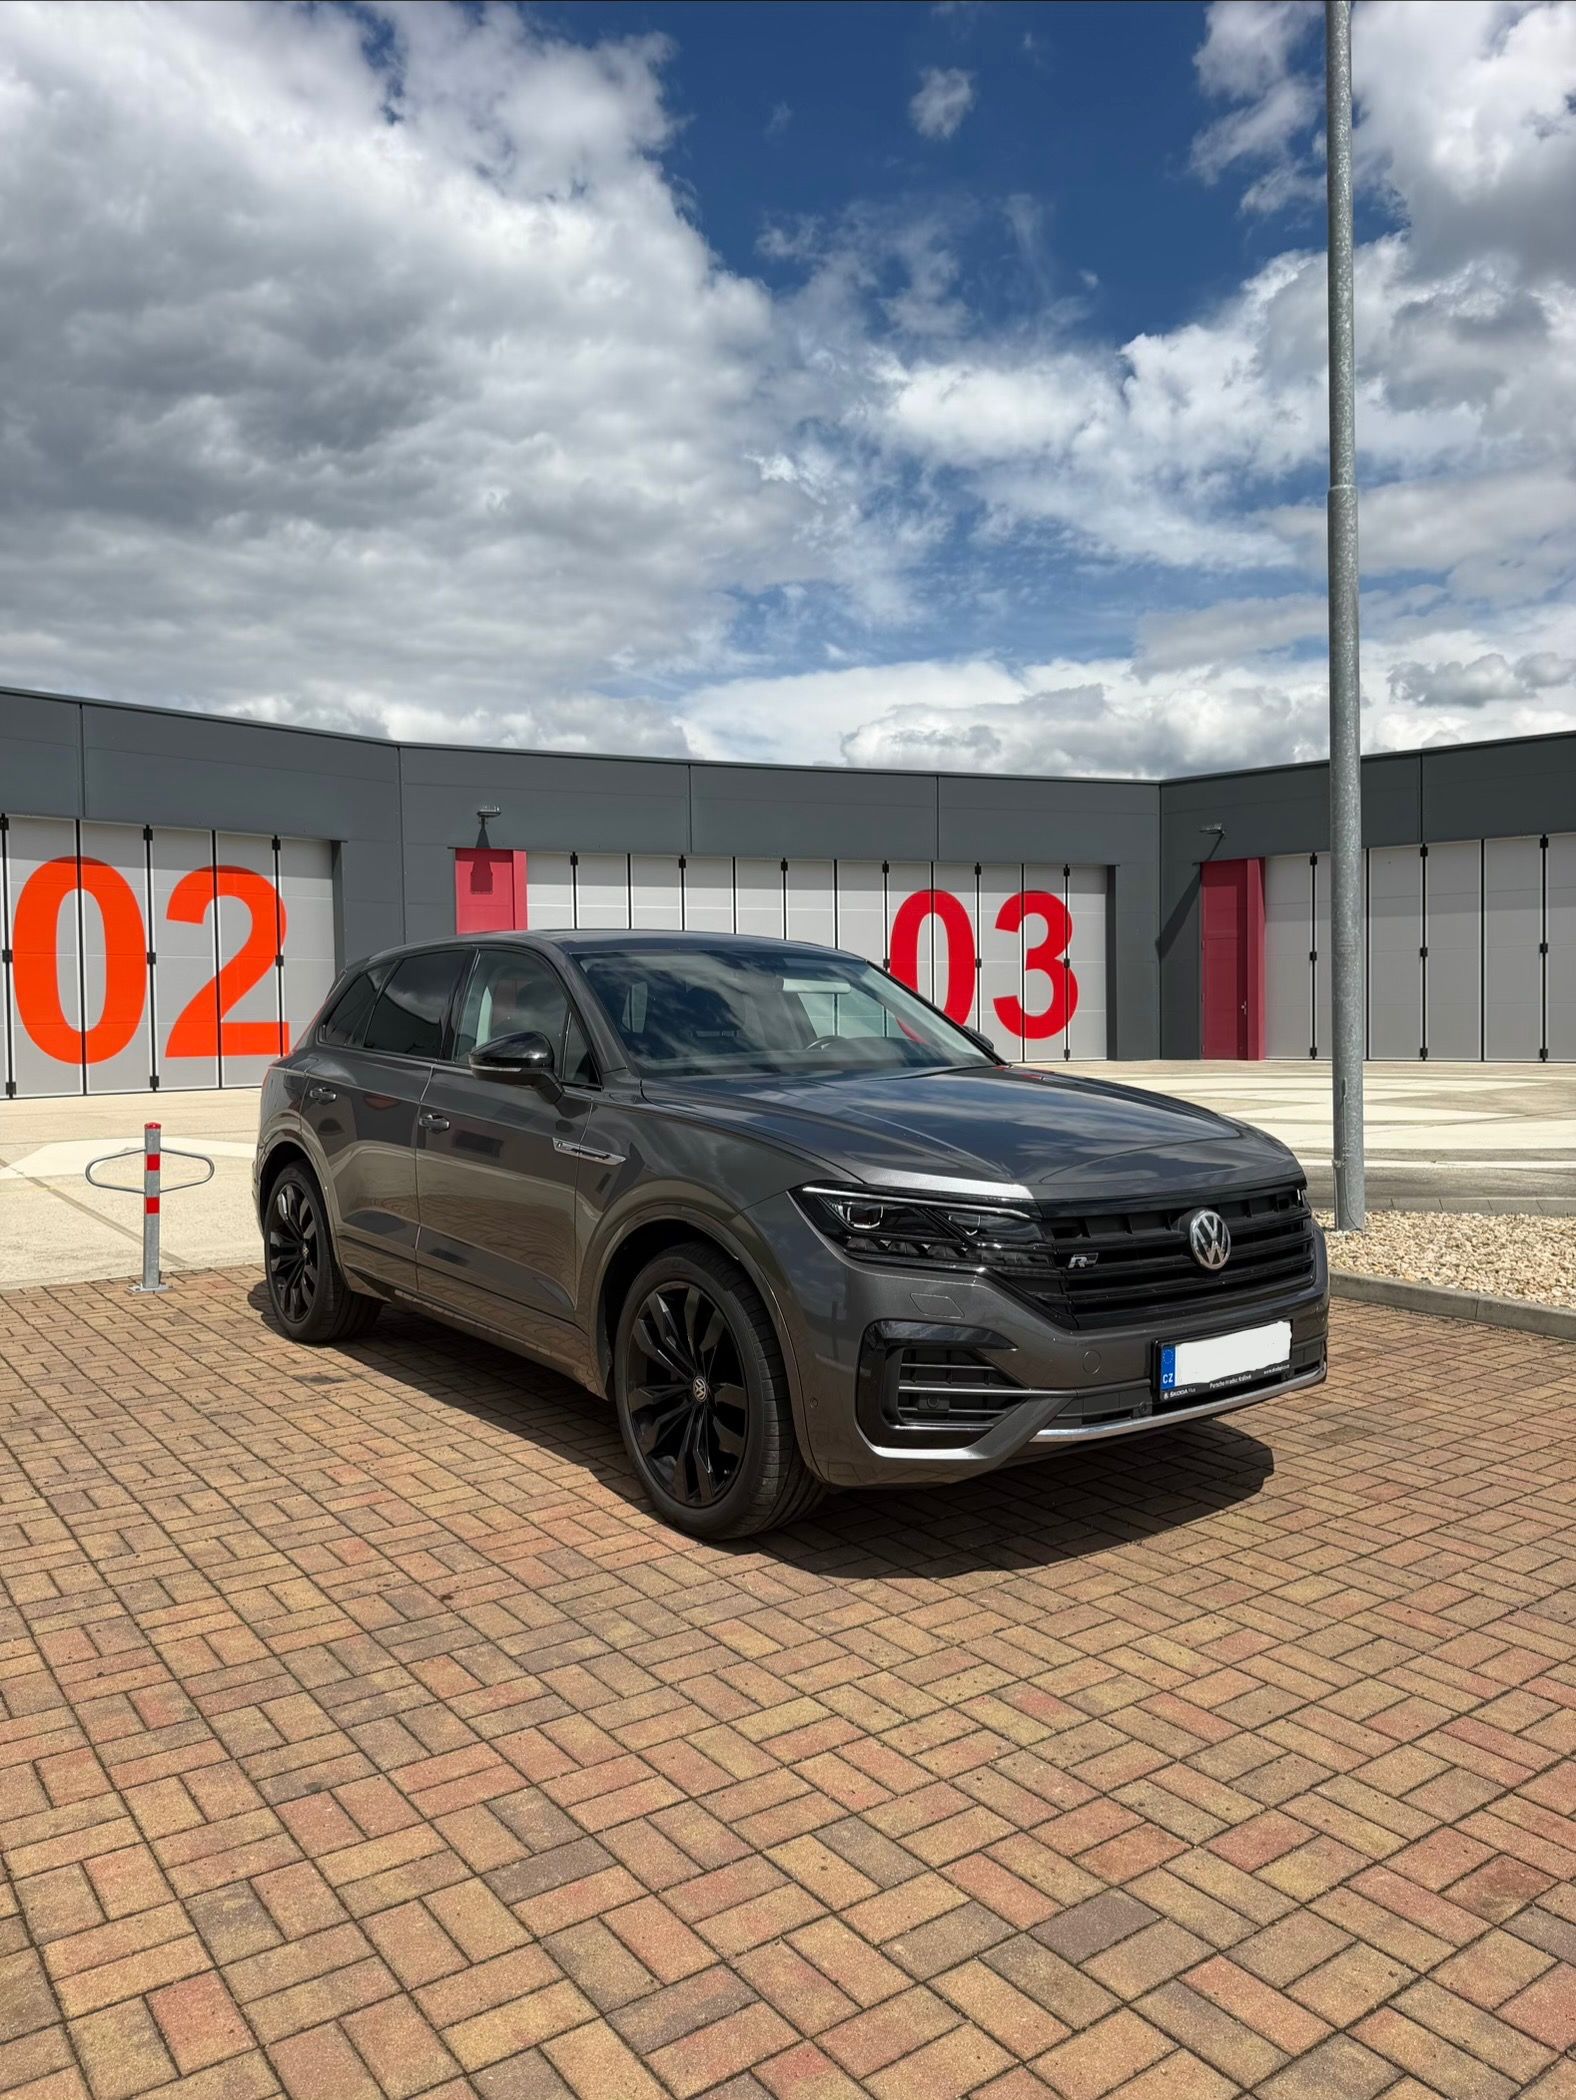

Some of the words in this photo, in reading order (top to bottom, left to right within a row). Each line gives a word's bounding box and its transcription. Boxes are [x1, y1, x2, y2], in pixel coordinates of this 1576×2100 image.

[12, 856, 290, 1064] 02
[889, 888, 1079, 1040] 03
[1190, 1210, 1232, 1270] VW
[1162, 1373, 1174, 1384] CZ
